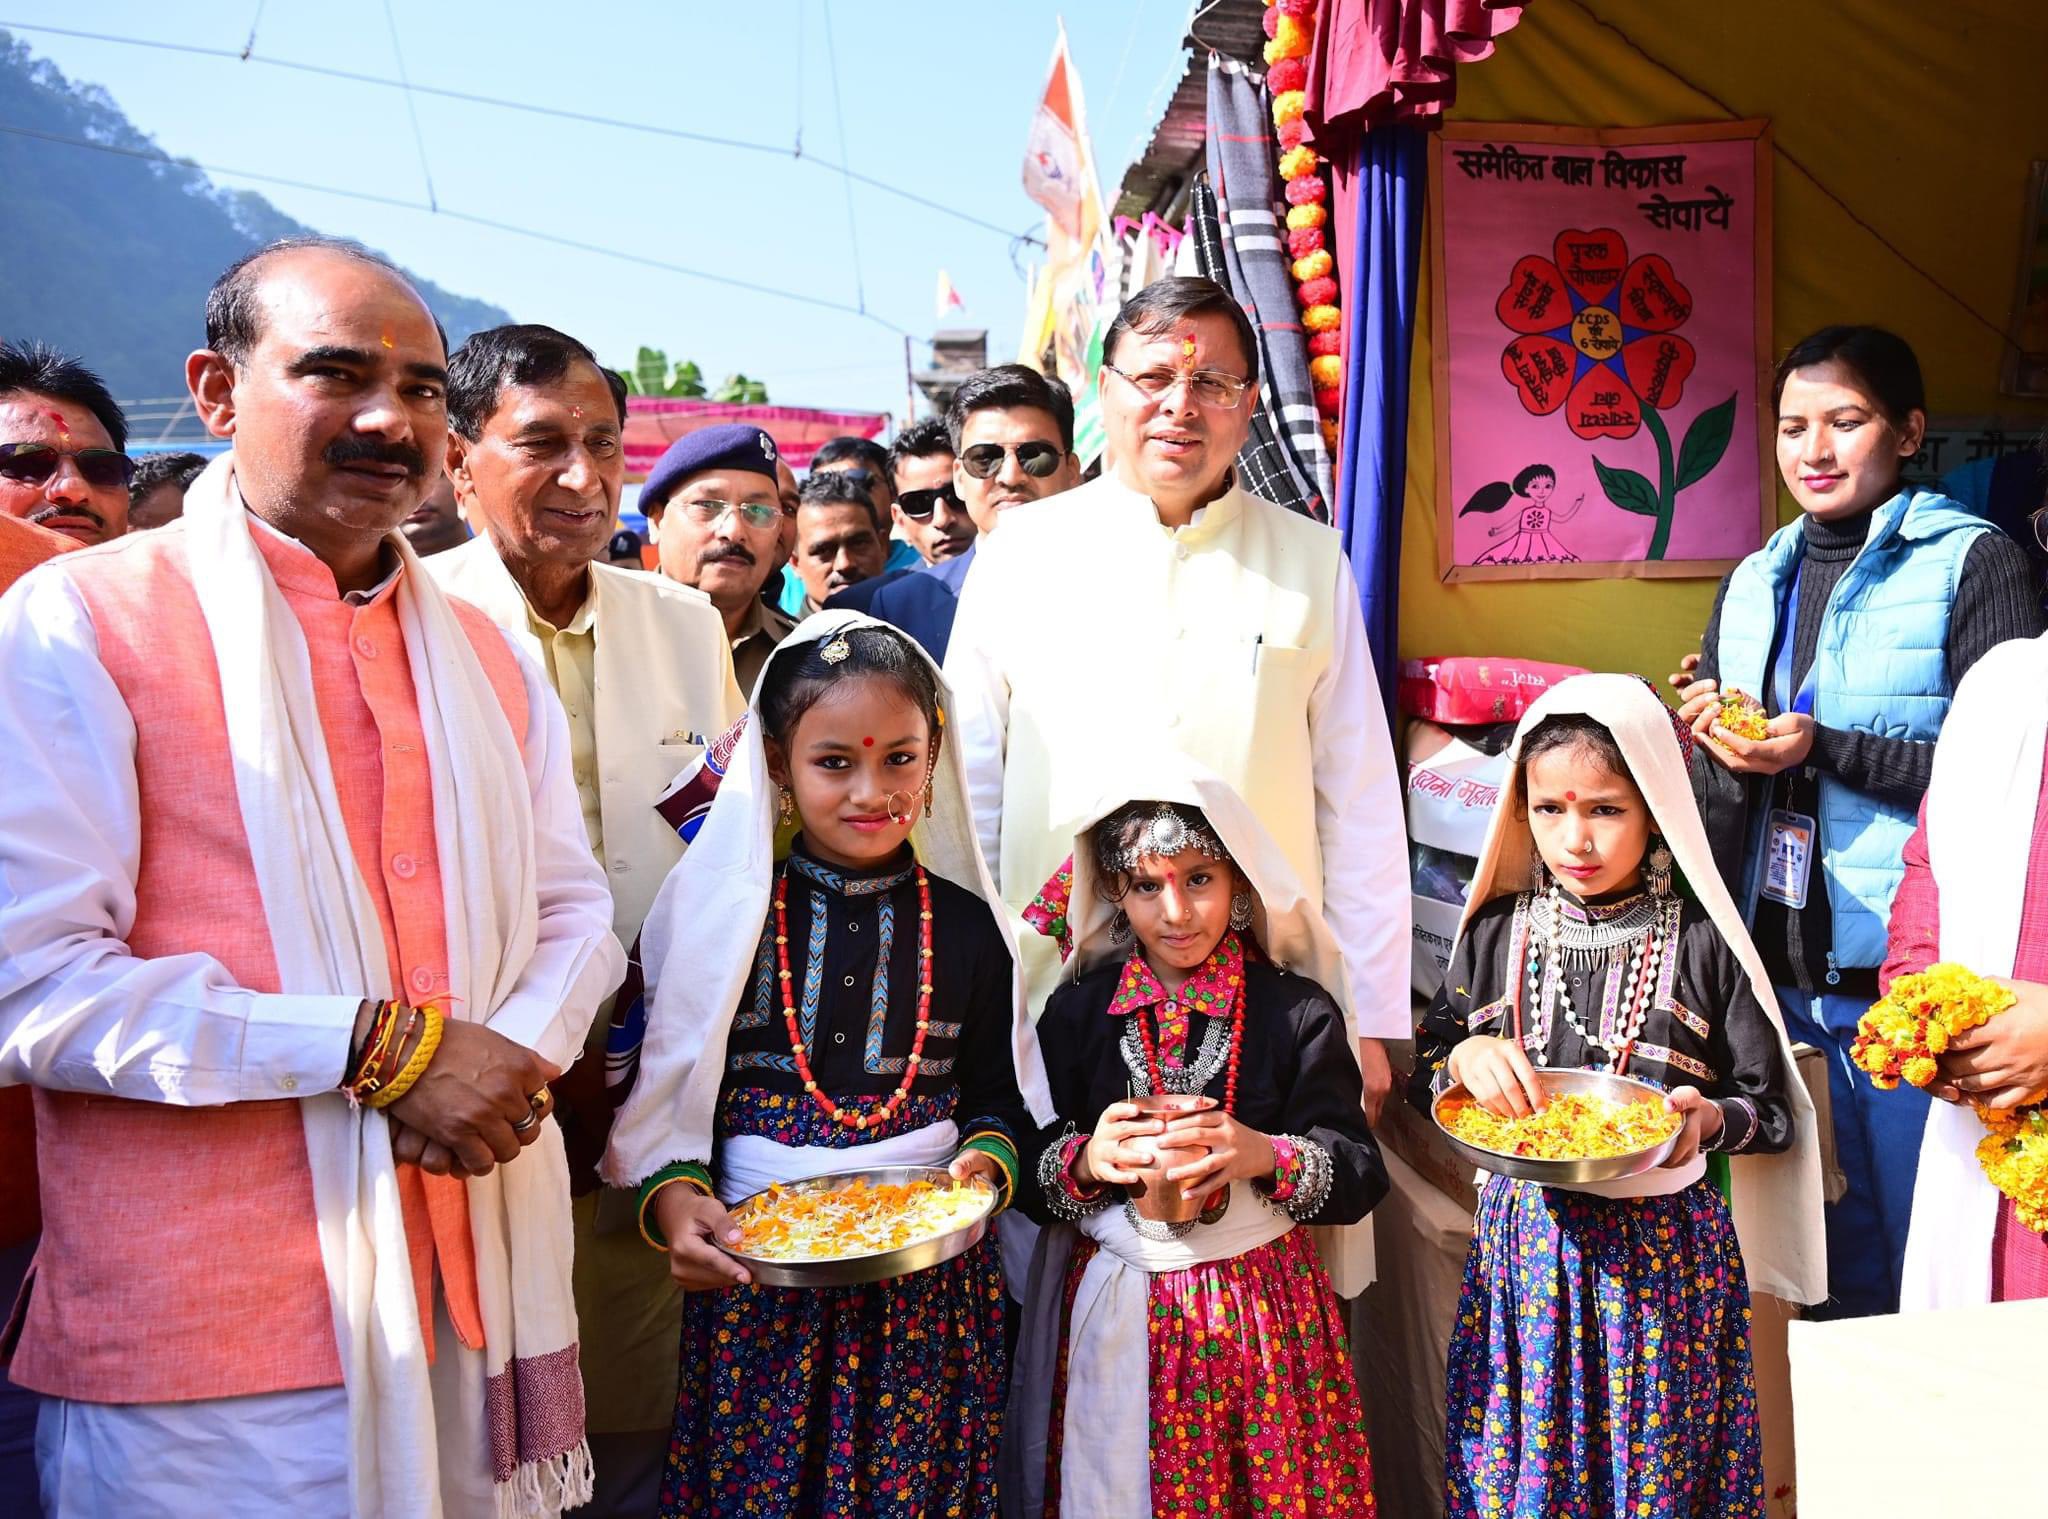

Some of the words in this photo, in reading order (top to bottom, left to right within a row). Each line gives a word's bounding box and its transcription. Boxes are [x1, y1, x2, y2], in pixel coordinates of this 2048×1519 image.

[1452, 144, 1549, 181] समेकित
[1552, 155, 1595, 187] बाल
[1598, 151, 1687, 189] विकास
[1577, 313, 1610, 325] ICDS
[1580, 338, 1589, 349] 6
